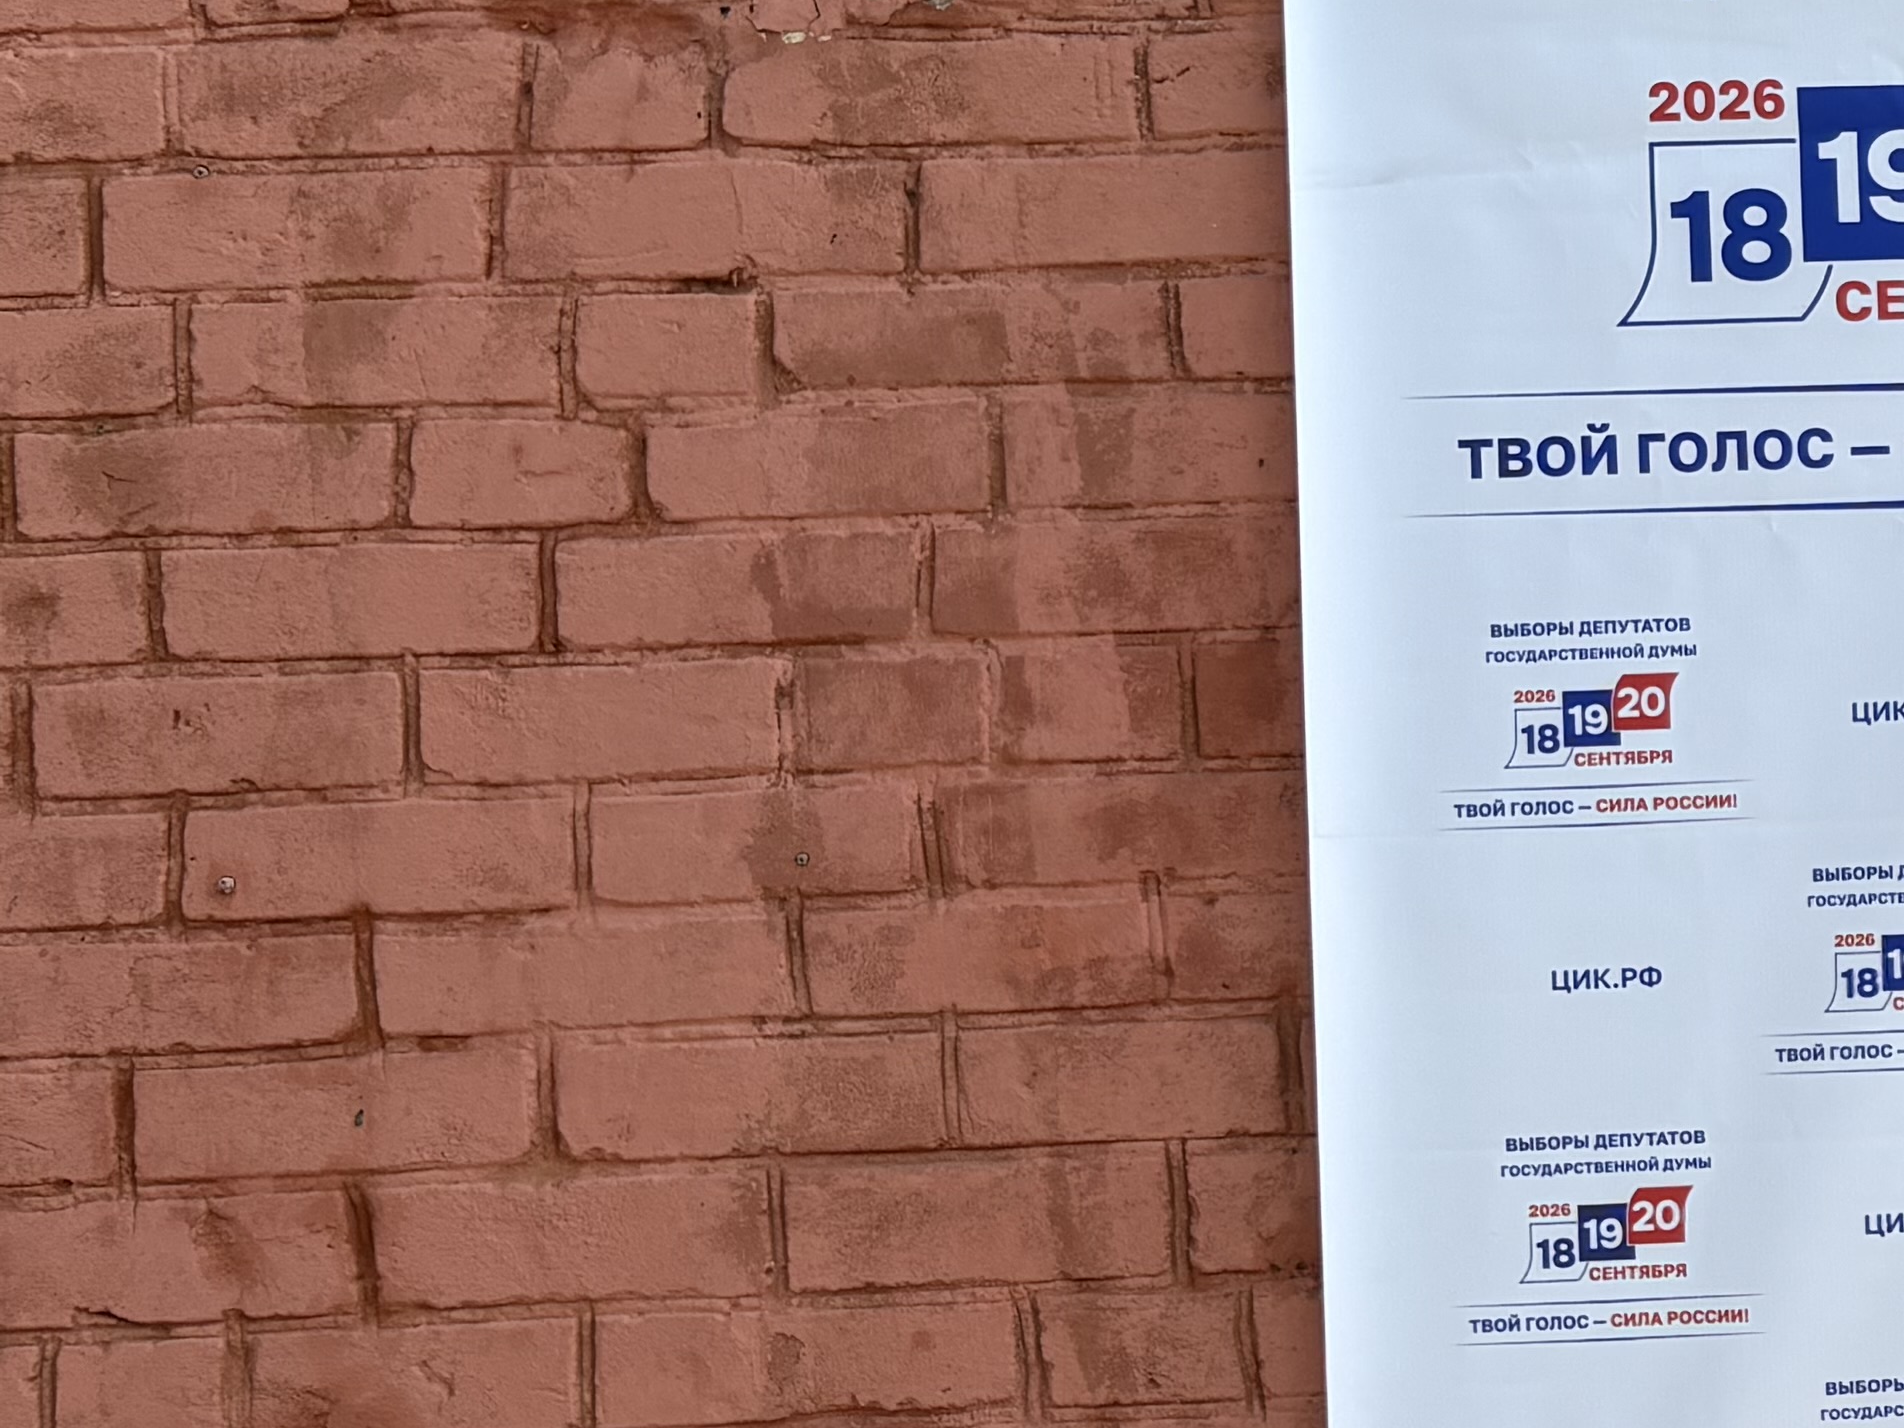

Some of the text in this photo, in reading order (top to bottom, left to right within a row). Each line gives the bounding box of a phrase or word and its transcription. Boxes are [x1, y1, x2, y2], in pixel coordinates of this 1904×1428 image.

[1648, 78, 1785, 123] 2026
[1669, 187, 1792, 283] 18
[1457, 422, 1619, 480] ТВОЙ
[1637, 427, 1835, 474] ГОЛОС
[1490, 617, 1691, 638] ВЫБОРЫ ДЕПУТАТОВ
[1485, 643, 1697, 664] ГОСУДАРСТВЕННОЙ ДУМЫ
[1513, 689, 1556, 704] 2026
[1520, 686, 1666, 755] 18 19 20
[1573, 749, 1673, 767] СЕНТЯБРЯ
[1453, 799, 1506, 819] ТВОЙ
[1510, 800, 1574, 817] ГОЛОС
[1595, 797, 1649, 813] СИЛА
[1652, 793, 1737, 811] РОССИИ!
[1551, 966, 1662, 994] ЦИК.РФ
[1505, 1130, 1706, 1152] ВЫБОРЫ ДЕПУТАТОВ
[1500, 1156, 1712, 1178] ГОСУДАРСТВЕННОЙ ДУМЫ
[1528, 1203, 1571, 1218] 2026
[1536, 1199, 1681, 1270] 18 19 20
[1588, 1263, 1688, 1282] СЕНТЯБРЯ
[1468, 1314, 1521, 1334] ТВОЙ
[1525, 1314, 1589, 1332] ГОЛОС
[1610, 1312, 1664, 1328] СИЛА
[1667, 1308, 1749, 1325] РОССИИ!
